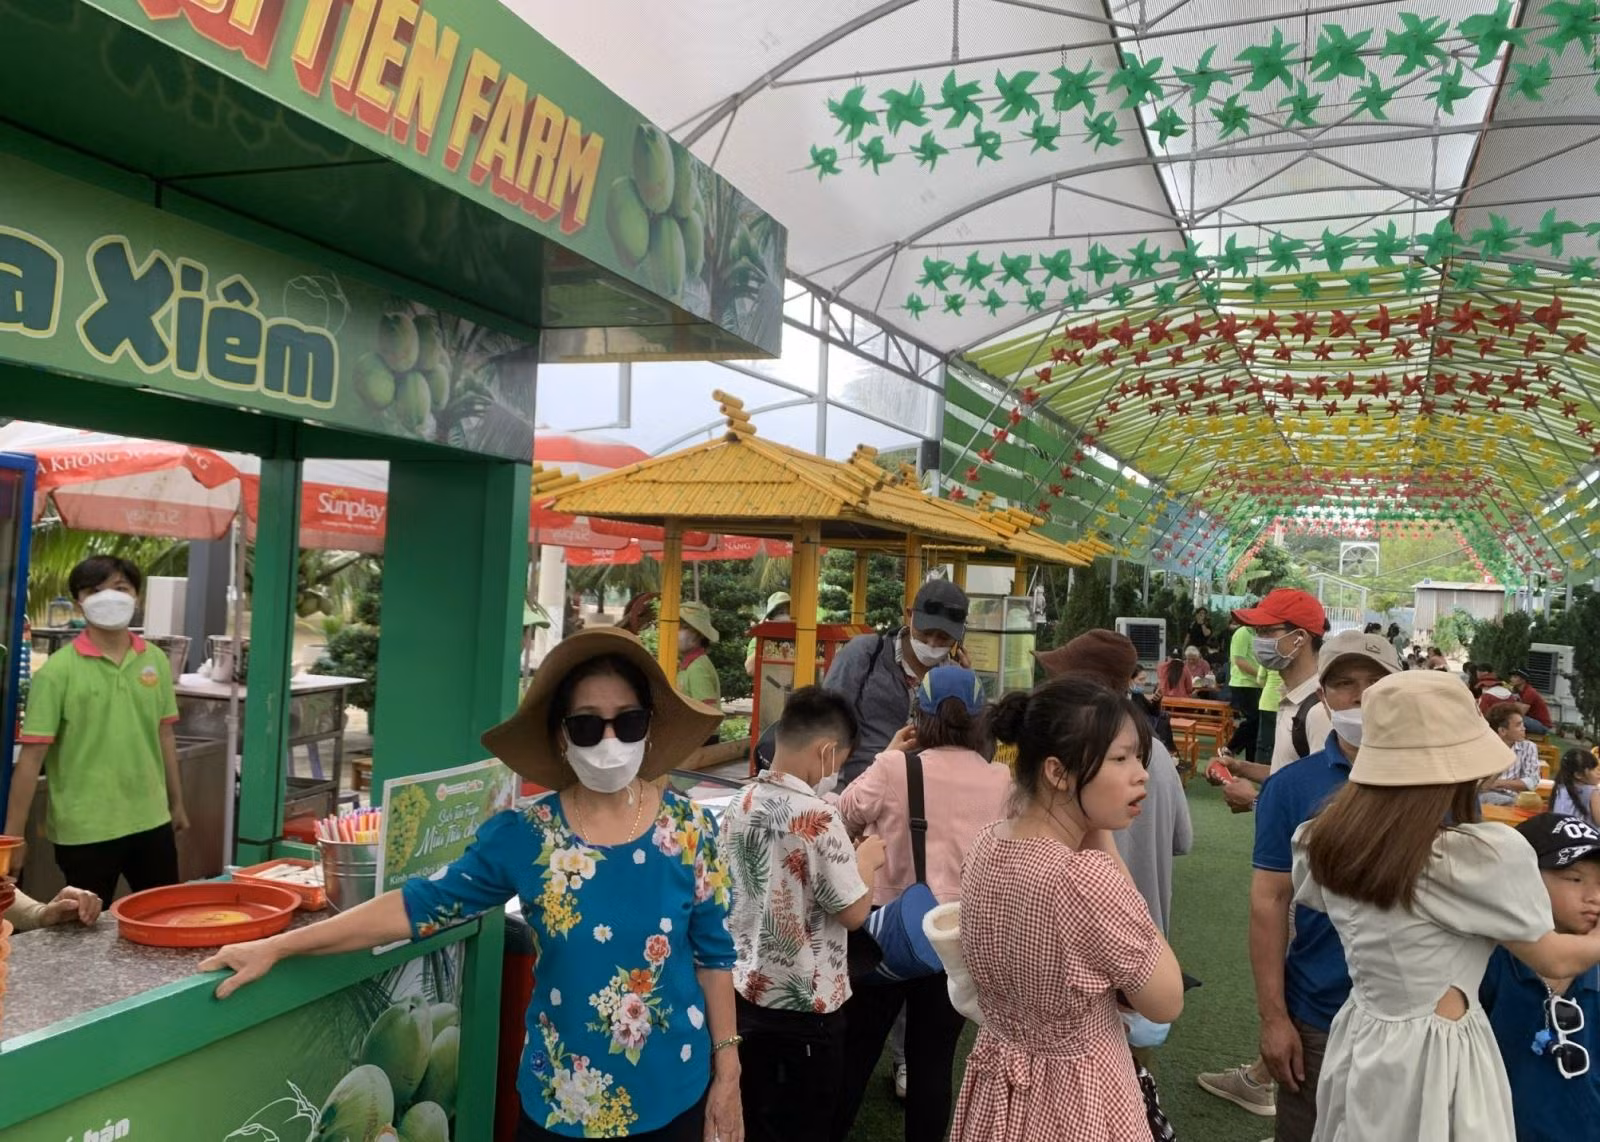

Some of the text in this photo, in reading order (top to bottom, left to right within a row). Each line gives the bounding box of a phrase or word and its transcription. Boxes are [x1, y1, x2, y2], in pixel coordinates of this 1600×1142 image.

[445, 48, 604, 231] FARM
[76, 234, 340, 409] Xiêm
[317, 492, 386, 524] Sunplay
[1563, 823, 1599, 840] 02
